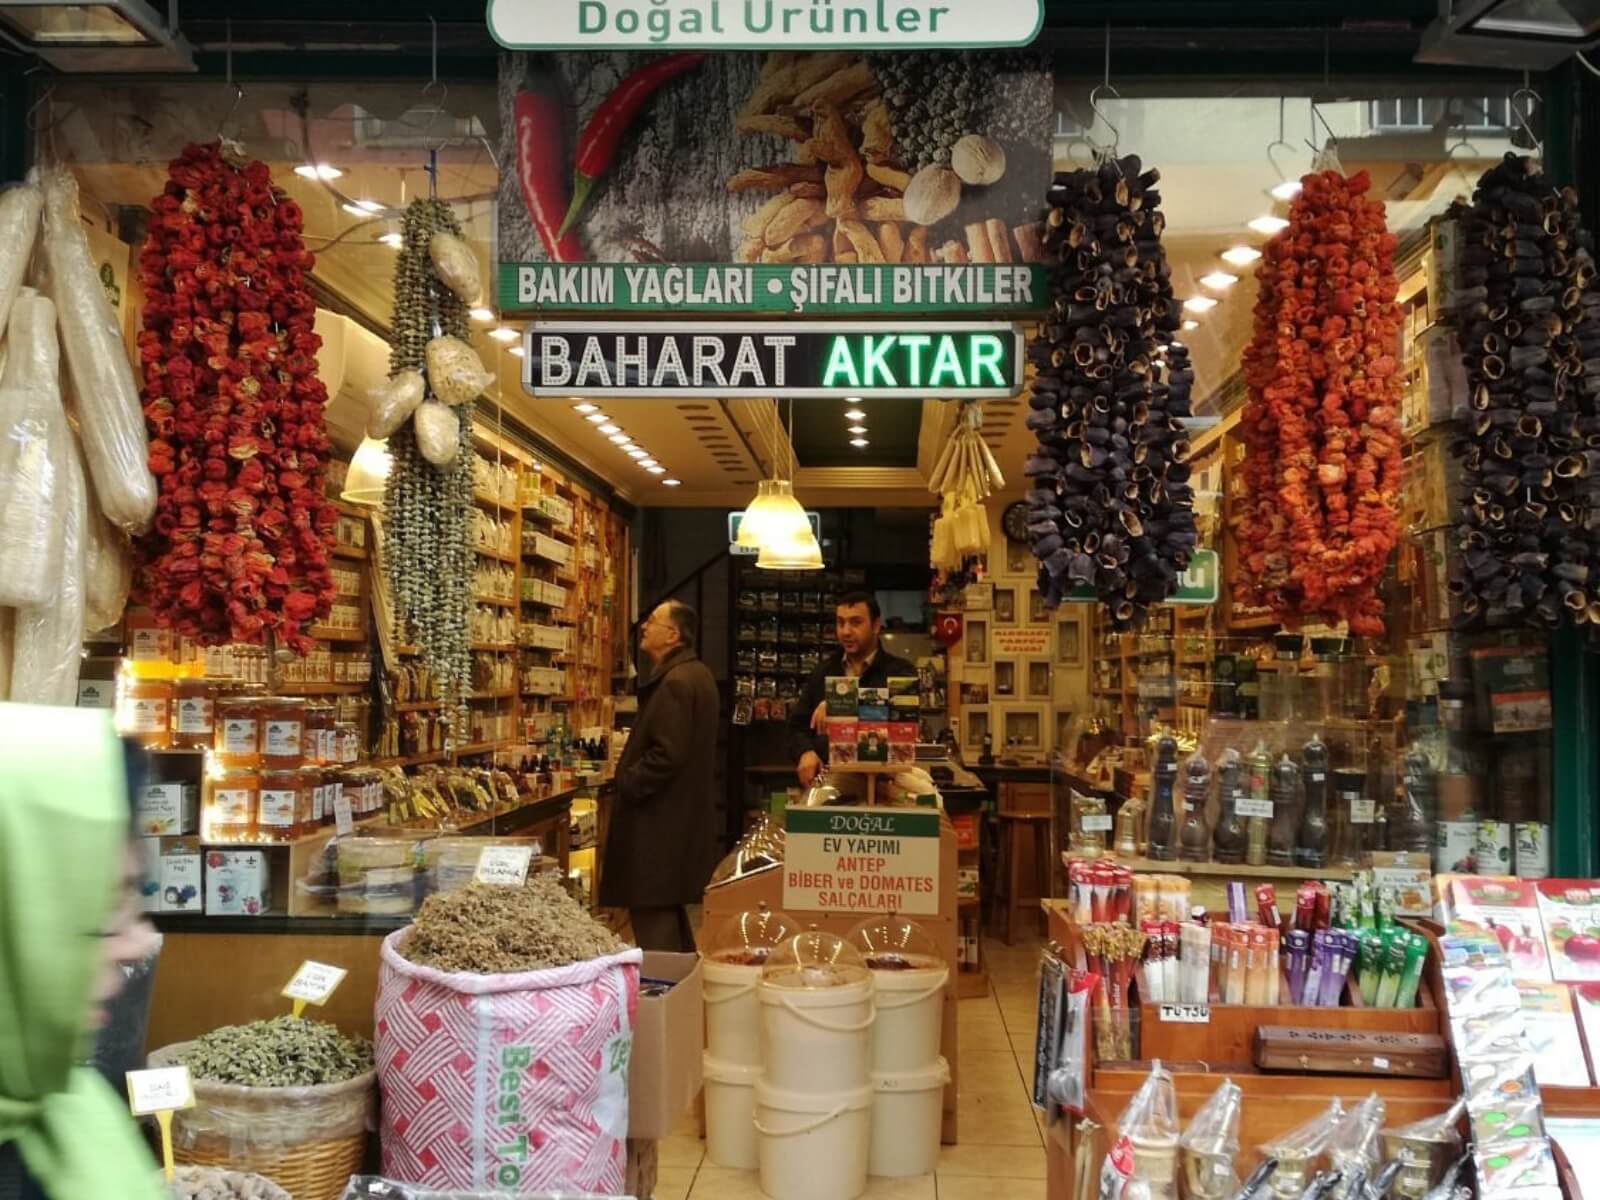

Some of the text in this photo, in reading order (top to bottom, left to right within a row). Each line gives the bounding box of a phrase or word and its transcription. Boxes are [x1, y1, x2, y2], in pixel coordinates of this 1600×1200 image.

[518, 266, 615, 304] BAKIM
[541, 334, 1007, 387] BAHARAT AKTAR
[830, 814, 895, 832] DOĞAL
[823, 838, 900, 855] EV YAPIMI
[836, 857, 886, 872] ANTEP
[837, 878, 854, 889] ve
[860, 875, 933, 892] DOMATES
[818, 891, 902, 909] SALÇALARI
